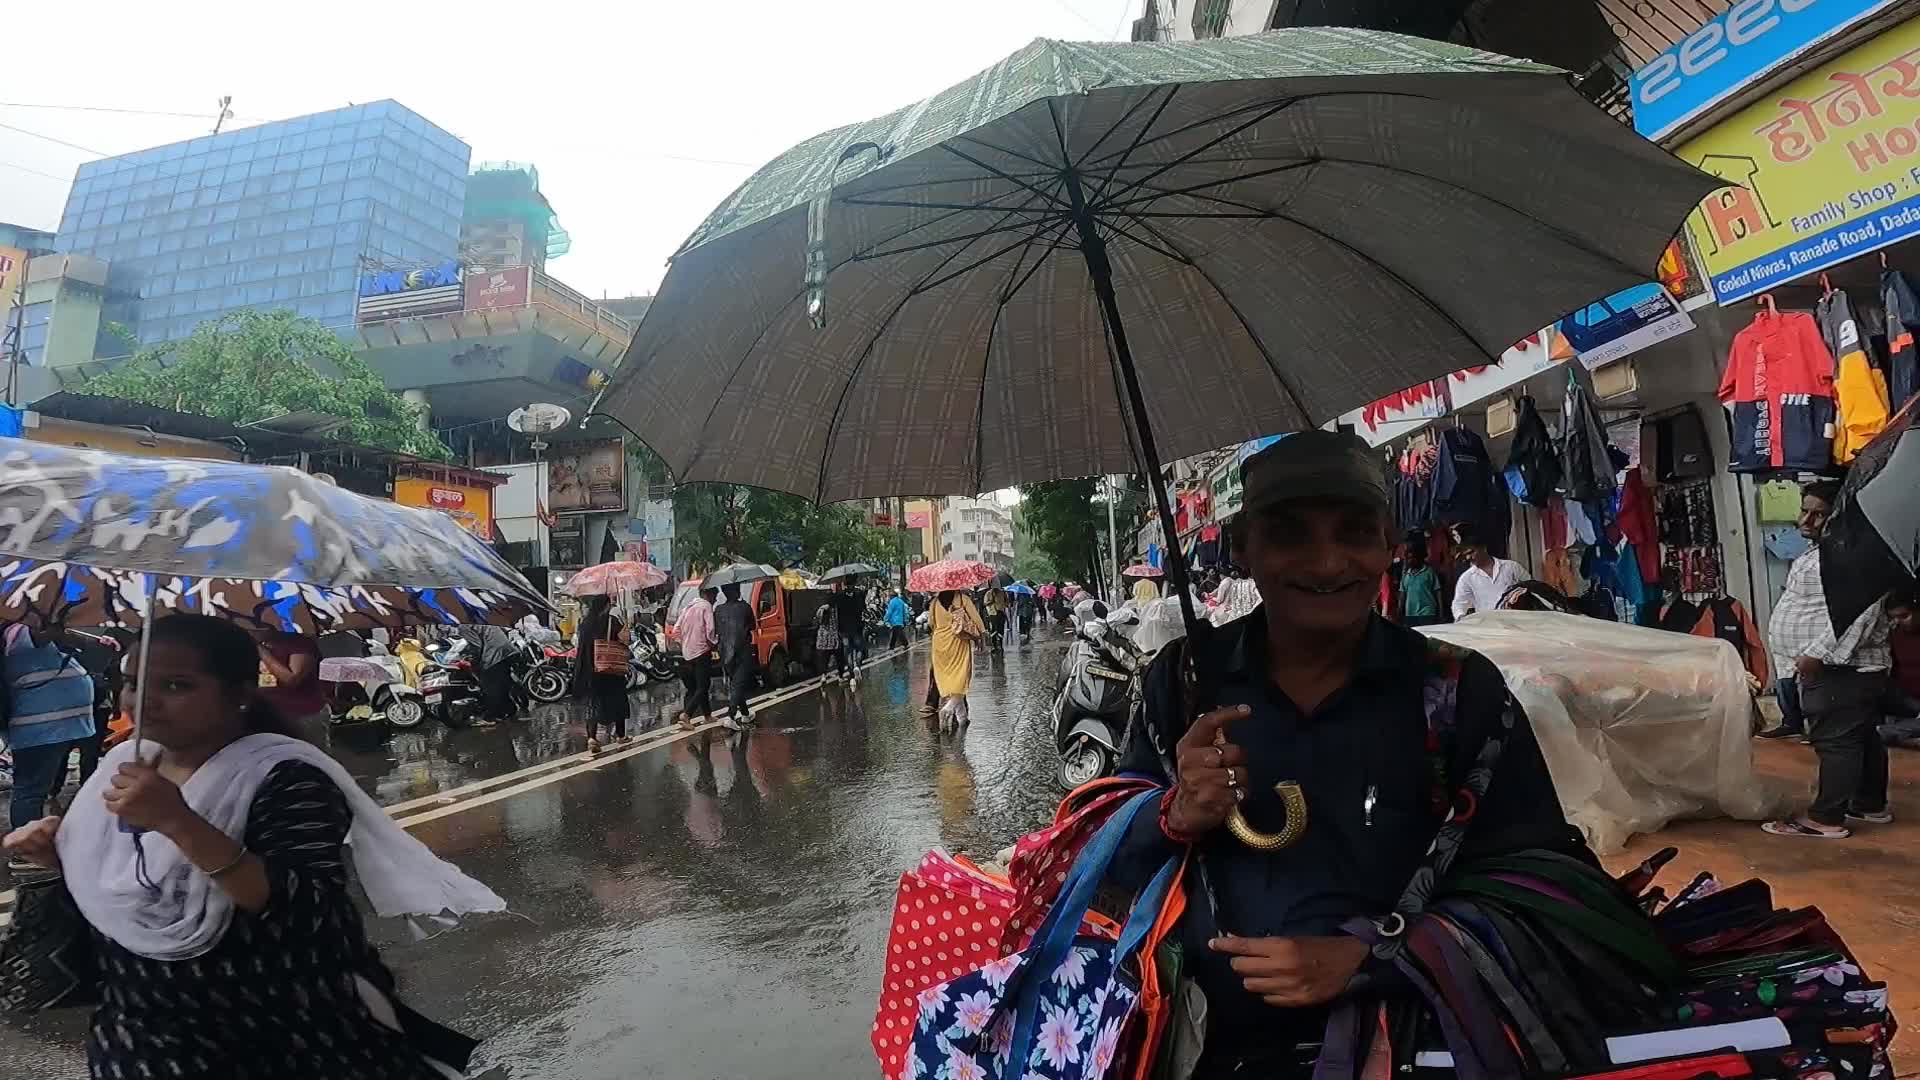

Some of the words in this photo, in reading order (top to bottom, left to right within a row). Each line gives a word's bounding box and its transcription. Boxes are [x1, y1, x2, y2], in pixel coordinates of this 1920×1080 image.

[1636, 0, 1818, 104] zee
[1847, 117, 1920, 172] HO
[1791, 201, 1847, 232] Family
[1848, 182, 1897, 209] Shop
[1718, 271, 1751, 294] Gokul
[1751, 258, 1791, 281] Niwas,
[1789, 239, 1839, 266] Ranade
[1838, 220, 1881, 248] Road,
